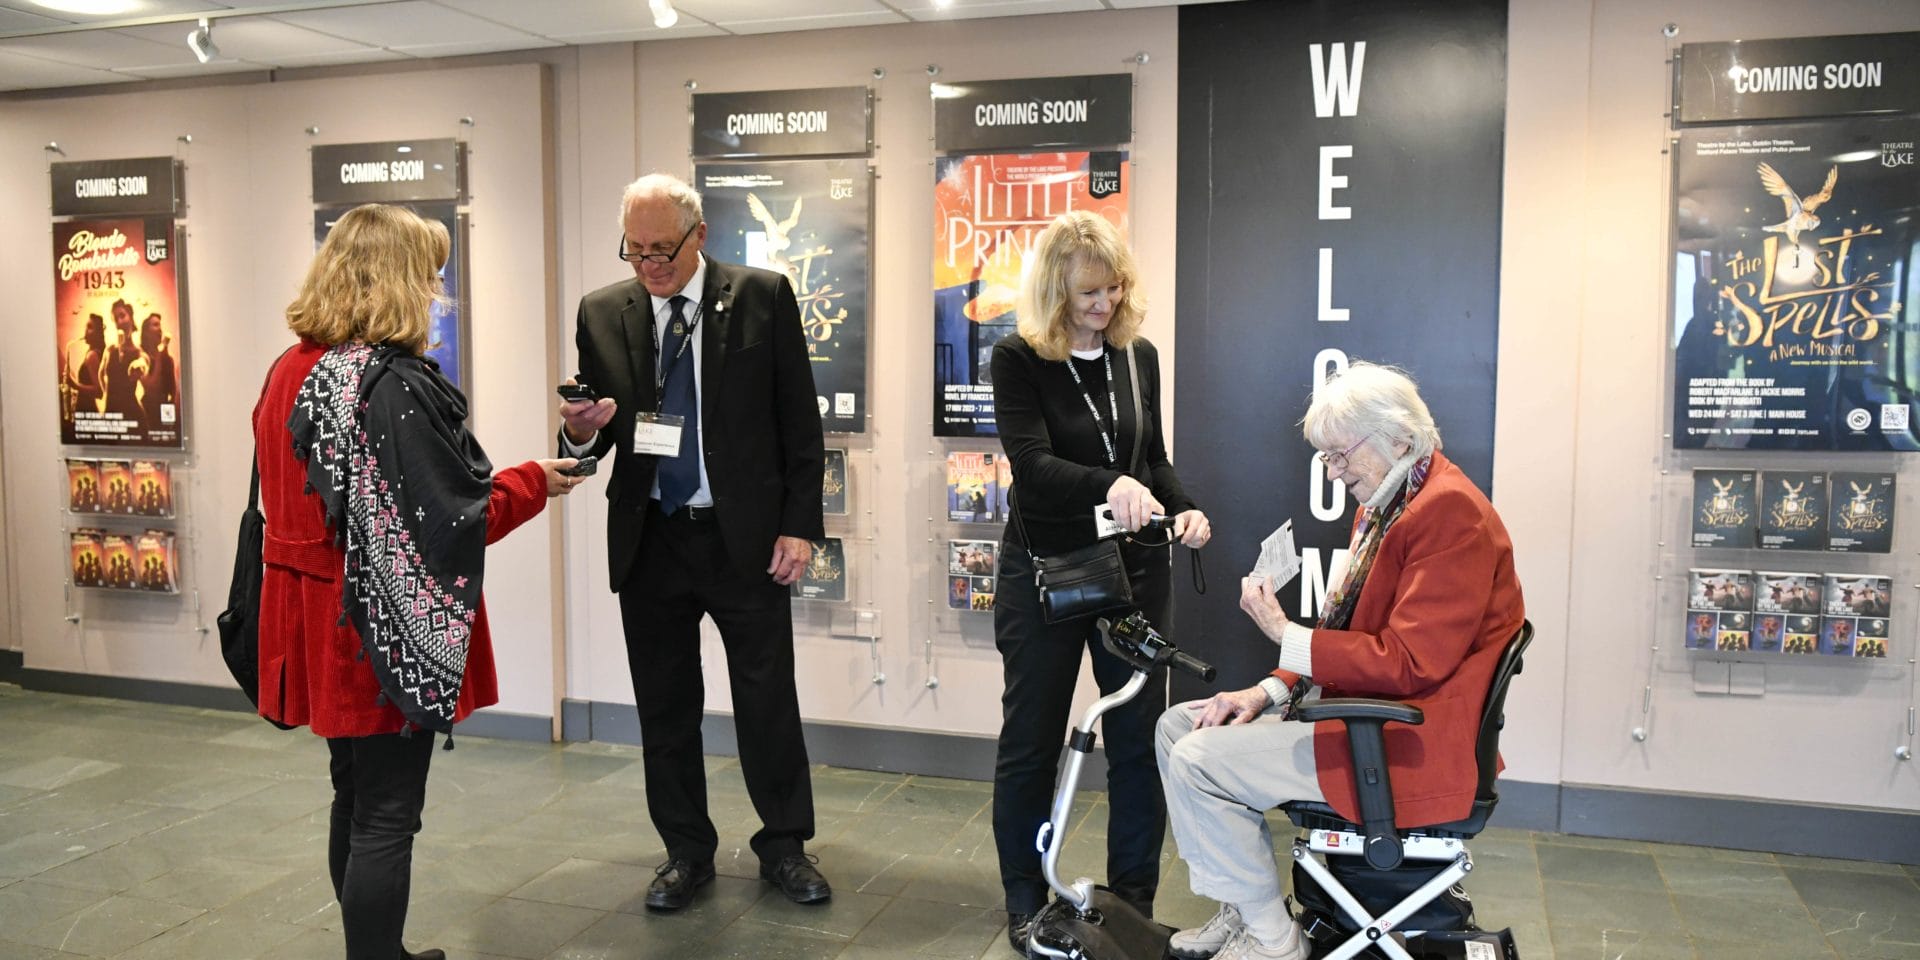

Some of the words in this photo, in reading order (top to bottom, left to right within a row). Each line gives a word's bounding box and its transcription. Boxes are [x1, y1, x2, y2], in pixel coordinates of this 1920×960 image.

[1734, 65, 1818, 93] COMING
[1824, 62, 1882, 89] SOON
[727, 112, 784, 135] COMING
[787, 111, 827, 133] SOON
[975, 103, 1038, 126] COMING
[1042, 100, 1087, 124] SOON
[341, 162, 389, 184] COMING
[390, 160, 424, 181] SOON
[1882, 153, 1914, 167] LAKE
[75, 178, 117, 198] COMING
[118, 176, 148, 196] SOON
[830, 187, 853, 199] LAKE
[974, 165, 1079, 226] LITTLE
[1092, 180, 1118, 193] LAKE
[68, 228, 127, 257] Blonde
[147, 248, 167, 261] LAKE
[58, 246, 140, 281] Bombshells
[83, 271, 126, 290] 1943
[1104, 352, 1113, 380] VOLUNTEER
[1689, 378, 1718, 387] ADAPTED
[1718, 378, 1736, 387] FROM
[1736, 378, 1748, 387] THE
[1766, 378, 1775, 387] BY
[1083, 392, 1100, 421] VOLUNTEER
[1109, 391, 1118, 420] VOLUNTEER
[1101, 431, 1115, 462] VOLUNTEER
